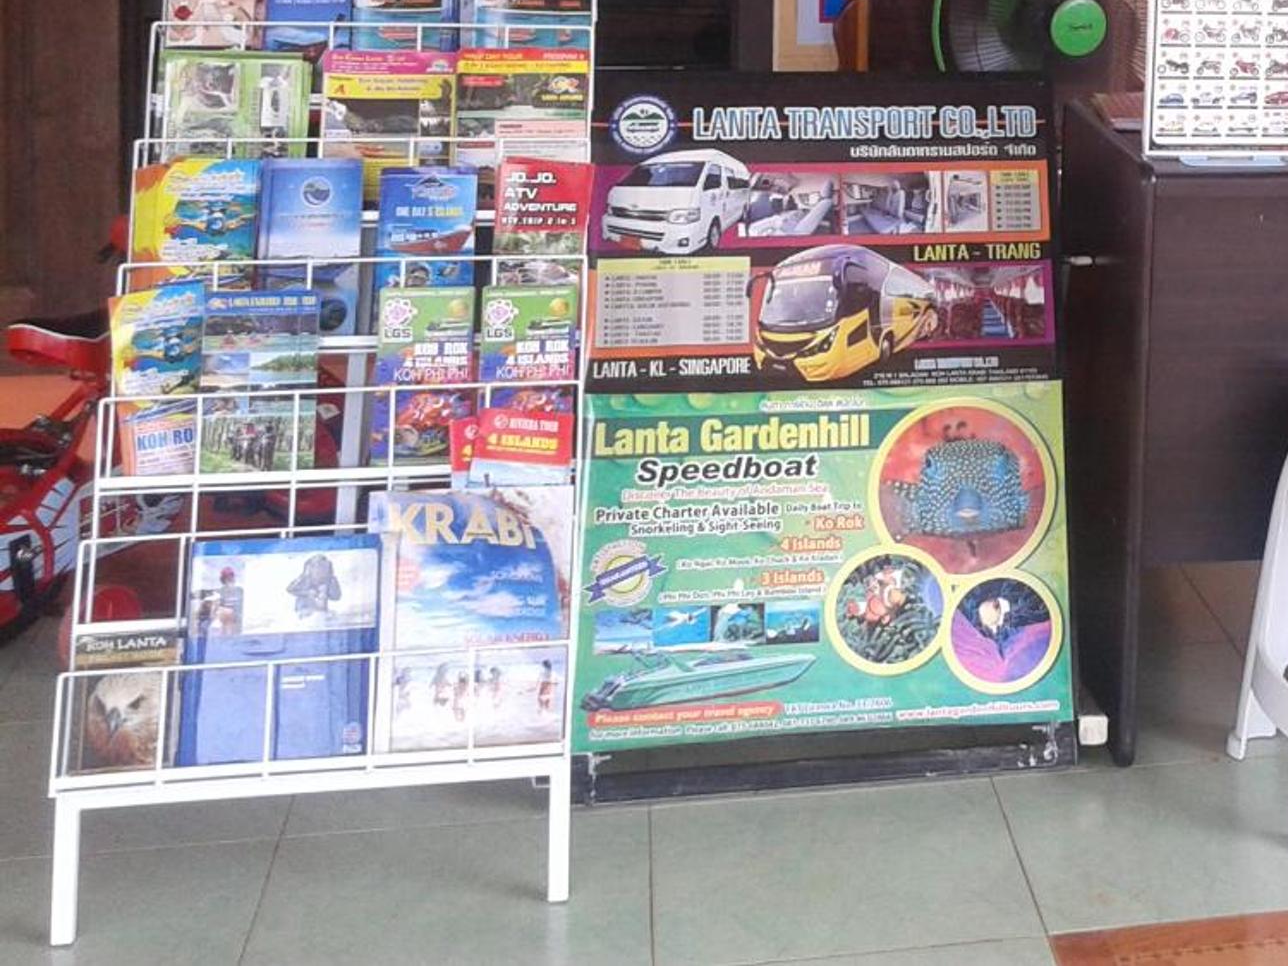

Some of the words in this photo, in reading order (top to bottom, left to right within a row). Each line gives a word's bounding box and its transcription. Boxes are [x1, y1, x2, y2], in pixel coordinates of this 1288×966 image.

[693, 106, 781, 141] LANTA
[787, 105, 936, 140] TRANSPORT
[504, 187, 539, 200] ATV
[504, 202, 577, 212] ADVENTURE
[914, 244, 969, 262] LANTA
[986, 242, 1041, 260] TRANG
[384, 328, 411, 338] LGS
[486, 328, 513, 338] LGS
[443, 341, 468, 355] ROK
[415, 355, 468, 367] ISLANDS
[517, 353, 569, 365] ISLANDS
[393, 367, 422, 381] KOH
[425, 367, 446, 380] PHI
[449, 367, 469, 380] PHI
[495, 366, 525, 379] KOH
[593, 359, 637, 379] LANTA
[649, 358, 667, 375] KL
[679, 355, 751, 375] SINGAPORE
[136, 432, 168, 451] KOH
[172, 428, 194, 445] RO
[595, 421, 690, 455] Lanta
[700, 414, 870, 452] Gardenhill
[487, 434, 498, 445] 4
[501, 435, 559, 450] ISLANDS
[637, 454, 817, 487] Speedboat
[753, 484, 808, 496] Andaman
[596, 507, 649, 521] Private
[653, 505, 708, 519] Charter
[712, 503, 779, 518] Available
[786, 503, 808, 514] Daily
[810, 503, 832, 512] Boat
[833, 502, 852, 512] Trip
[388, 502, 537, 549] KRABI
[631, 522, 694, 536] Snorkeling
[696, 522, 706, 533] &
[815, 517, 835, 530] Ko
[837, 515, 864, 530] Rok
[780, 538, 790, 550] 4
[792, 536, 842, 550] Islands
[773, 571, 824, 584] Islands
[86, 640, 115, 653] KOH
[117, 636, 167, 650] LANTA
[595, 712, 630, 723] Please
[677, 710, 700, 722] your
[738, 706, 775, 718] agency
